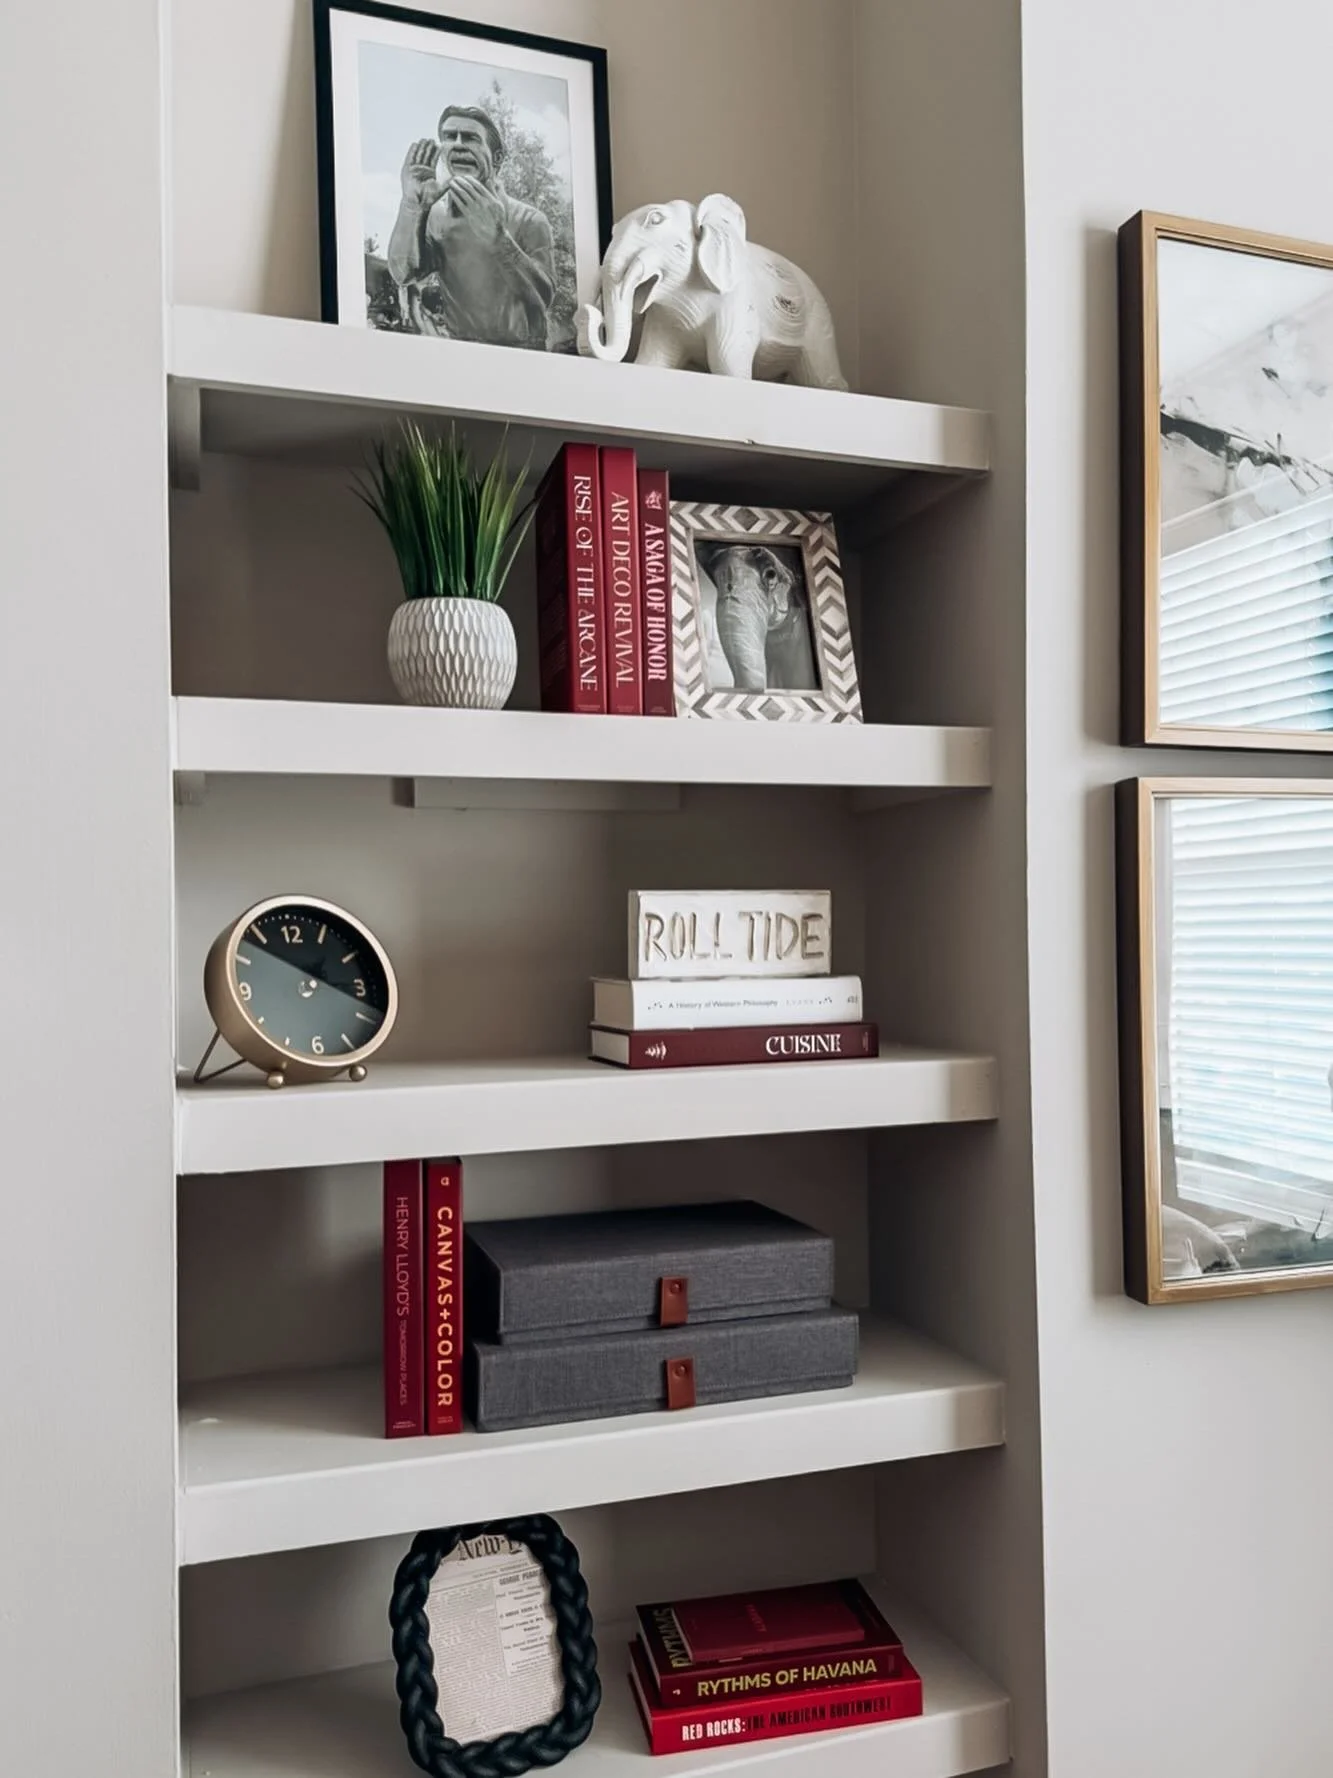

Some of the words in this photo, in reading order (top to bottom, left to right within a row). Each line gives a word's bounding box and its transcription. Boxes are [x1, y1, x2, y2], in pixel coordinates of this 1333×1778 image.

[573, 475, 592, 521] RISE
[611, 491, 630, 537] ART
[576, 526, 594, 556] OF
[645, 523, 664, 536] A
[612, 540, 632, 598] DECO
[646, 537, 665, 584] SAGA
[577, 563, 595, 604] THE
[647, 586, 666, 615] OF
[577, 608, 598, 691] ARCANE
[613, 602, 634, 688] REVIVAL
[647, 616, 668, 681] HONOR
[281, 925, 303, 944] 12
[644, 911, 733, 962] ROLL
[738, 911, 824, 962] TIDE
[239, 982, 252, 1001] 9
[353, 979, 366, 997] 3
[311, 1035, 325, 1054] 6
[765, 1033, 842, 1056] CUISINE
[396, 1196, 410, 1253] HENRY
[396, 1254, 410, 1317] LLOYD'S
[697, 1673, 771, 1697] RYTHMS
[775, 1668, 799, 1686] OF
[803, 1658, 878, 1682] HAVANA
[682, 1722, 703, 1741] RED
[706, 1717, 746, 1738] ROCKS:
[747, 1714, 765, 1731] THE
[769, 1707, 826, 1726] AMERICAN
[829, 1696, 892, 1718] SOUTHWEST
